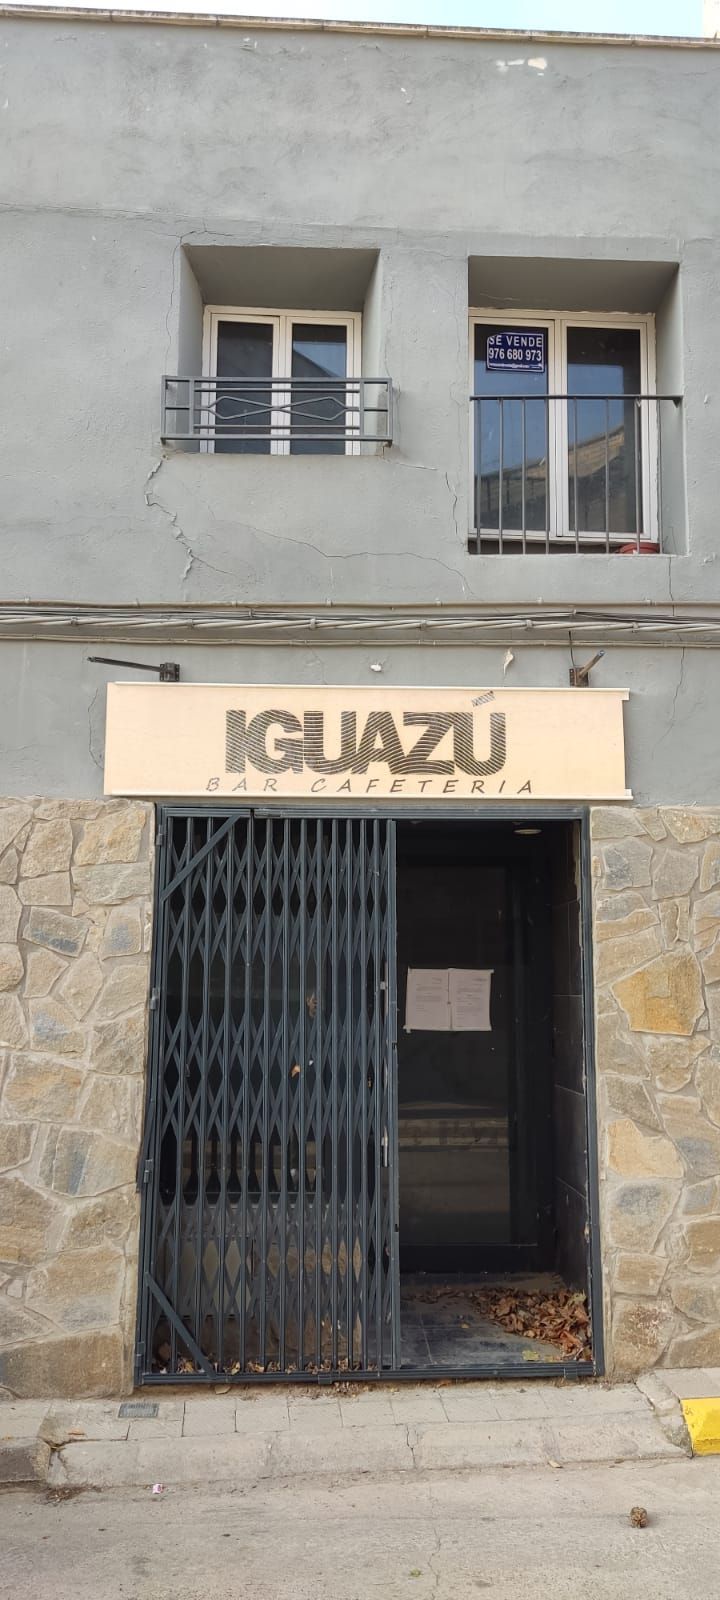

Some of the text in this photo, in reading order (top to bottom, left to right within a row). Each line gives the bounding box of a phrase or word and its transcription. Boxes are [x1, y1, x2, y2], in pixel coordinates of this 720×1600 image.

[489, 335, 542, 347] SE VENDE
[489, 348, 542, 361] 976 680 973
[225, 690, 506, 776] IGUAZÚ
[205, 778, 534, 794] BAR CAFETERIA
